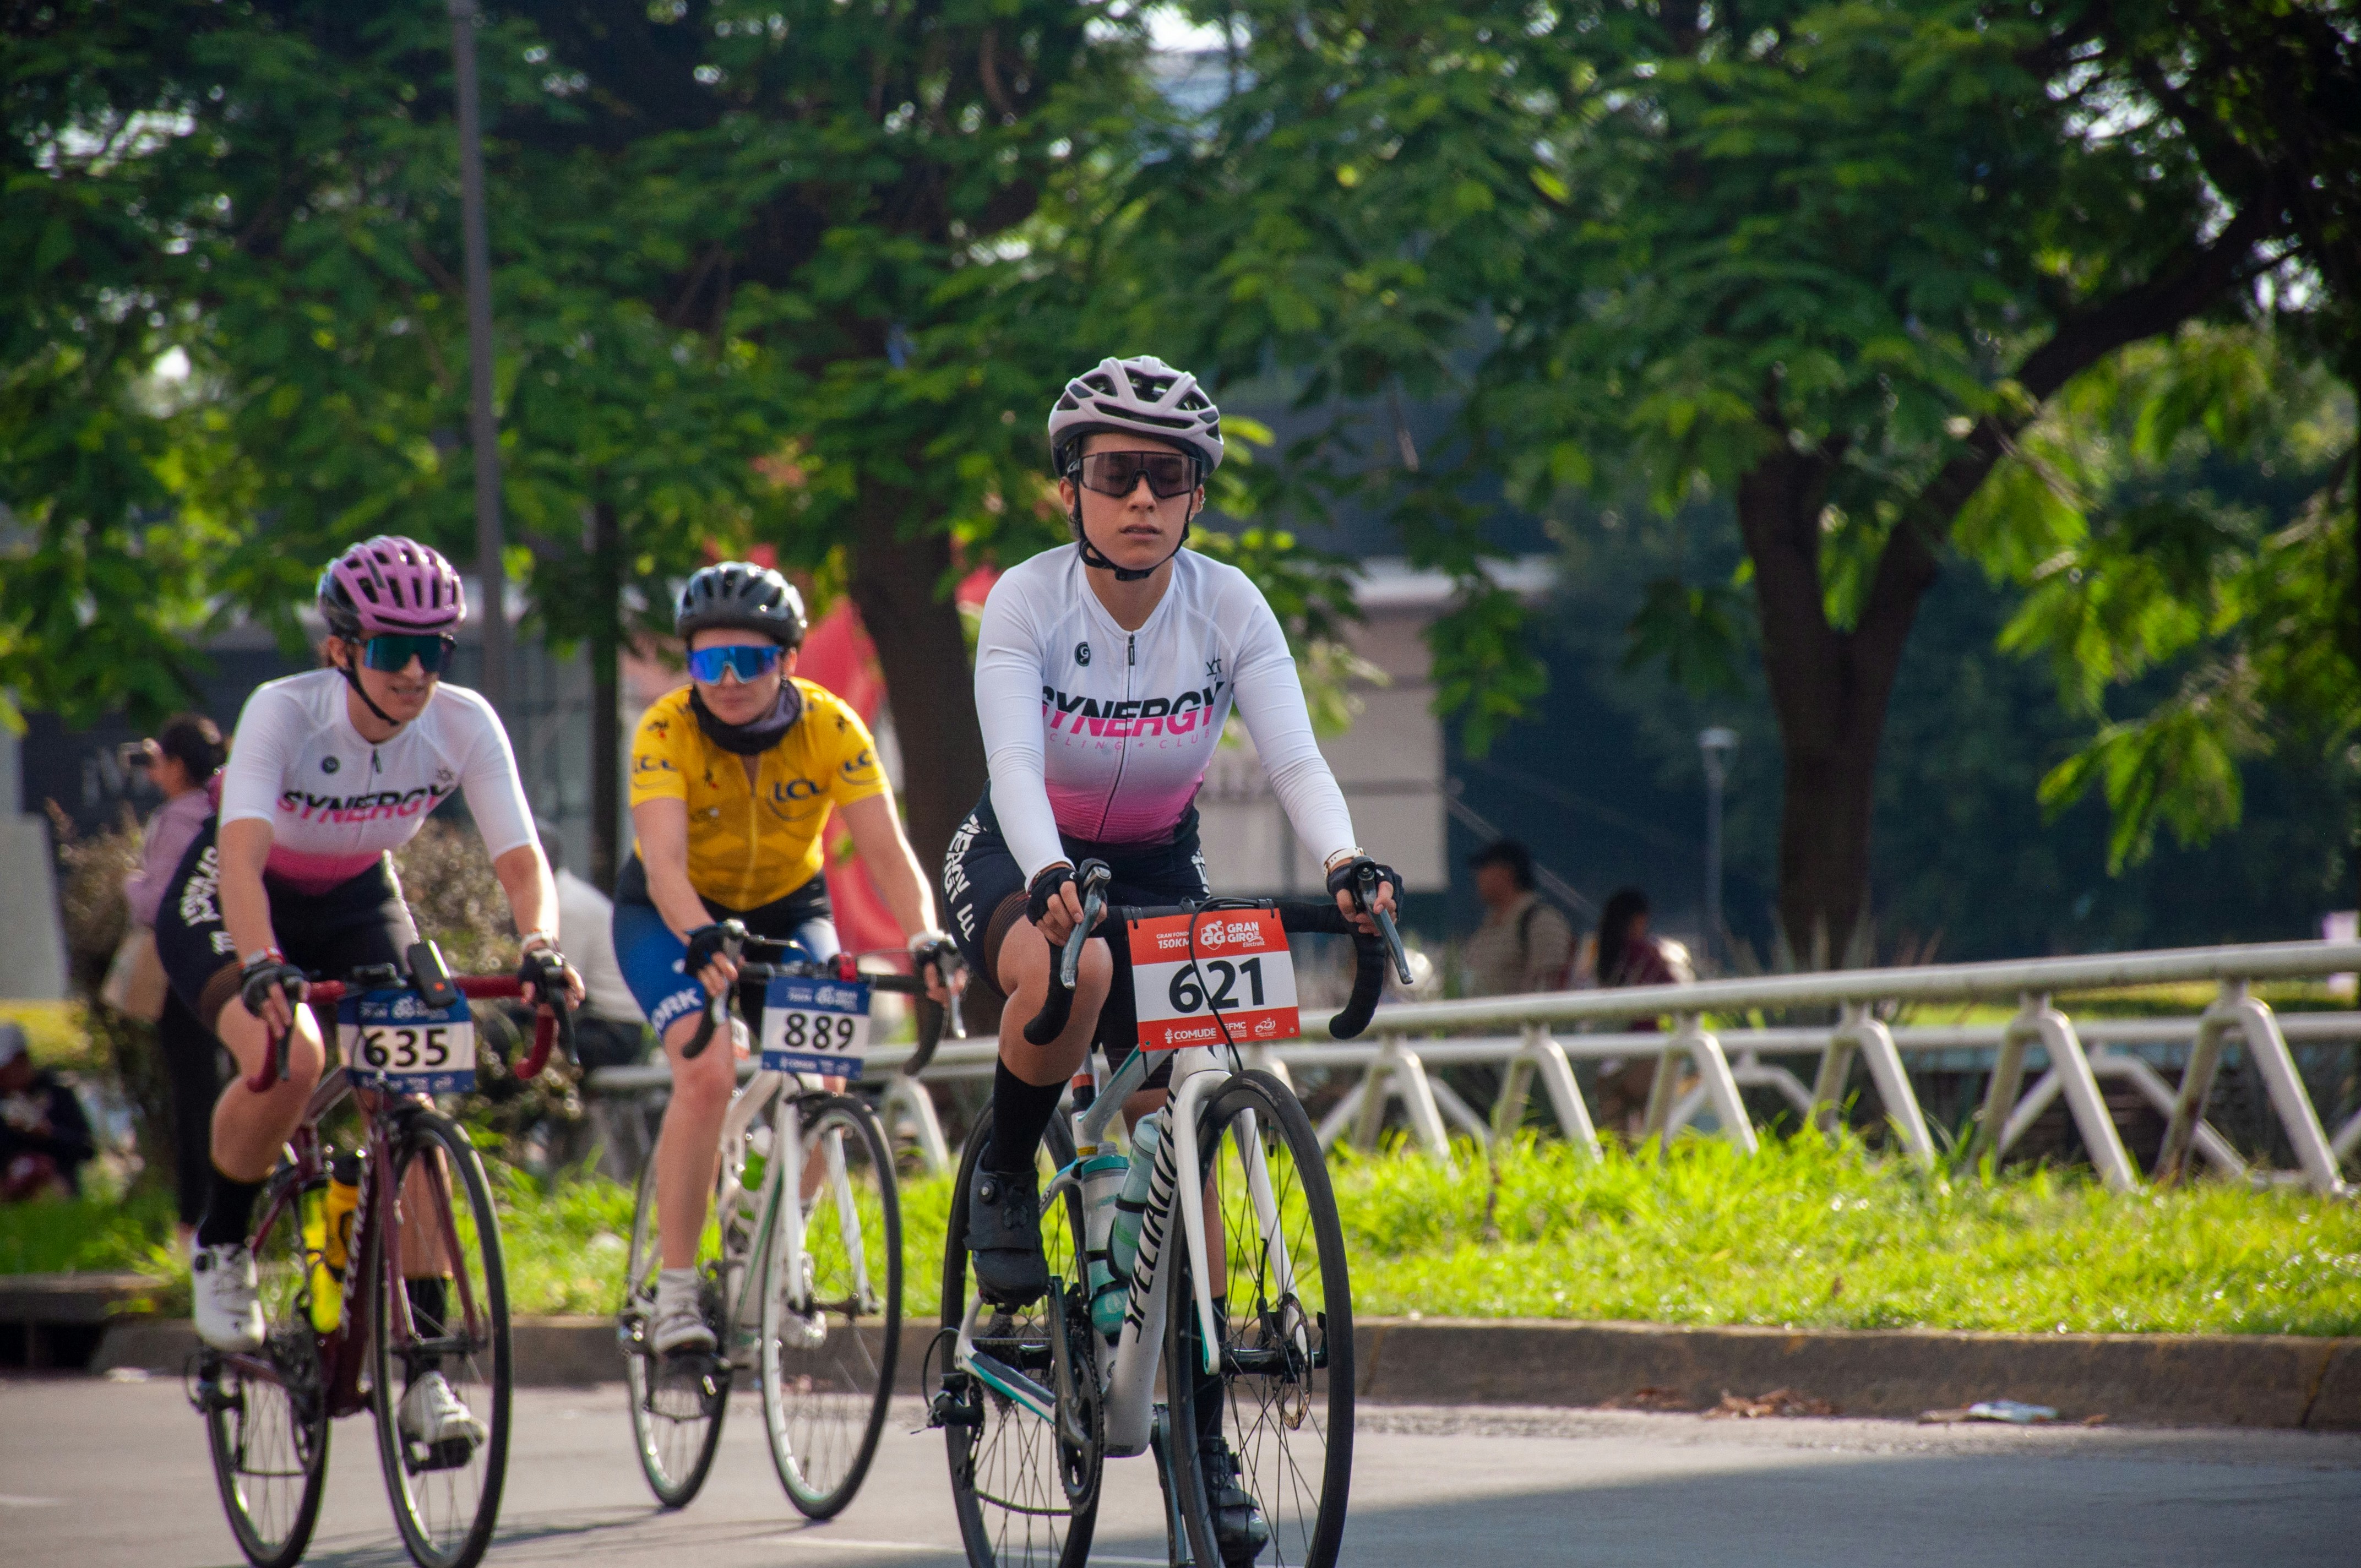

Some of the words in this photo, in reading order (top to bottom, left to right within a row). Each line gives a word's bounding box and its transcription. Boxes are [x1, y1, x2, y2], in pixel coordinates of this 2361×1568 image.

[1042, 681, 1225, 737] SYNERGY
[1049, 733, 1122, 750] CLING
[1158, 728, 1210, 749] CLUB
[844, 748, 874, 772] LC
[774, 777, 830, 802] LCL
[277, 784, 456, 824] SYNERGY
[1227, 922, 1259, 934] GRAN
[1227, 933, 1253, 943] GIRO
[1158, 938, 1189, 949] 150KM
[1169, 957, 1264, 1013] 621
[785, 1013, 856, 1050] 889
[1174, 1027, 1216, 1040] COMUDE
[364, 1028, 450, 1067] 635
